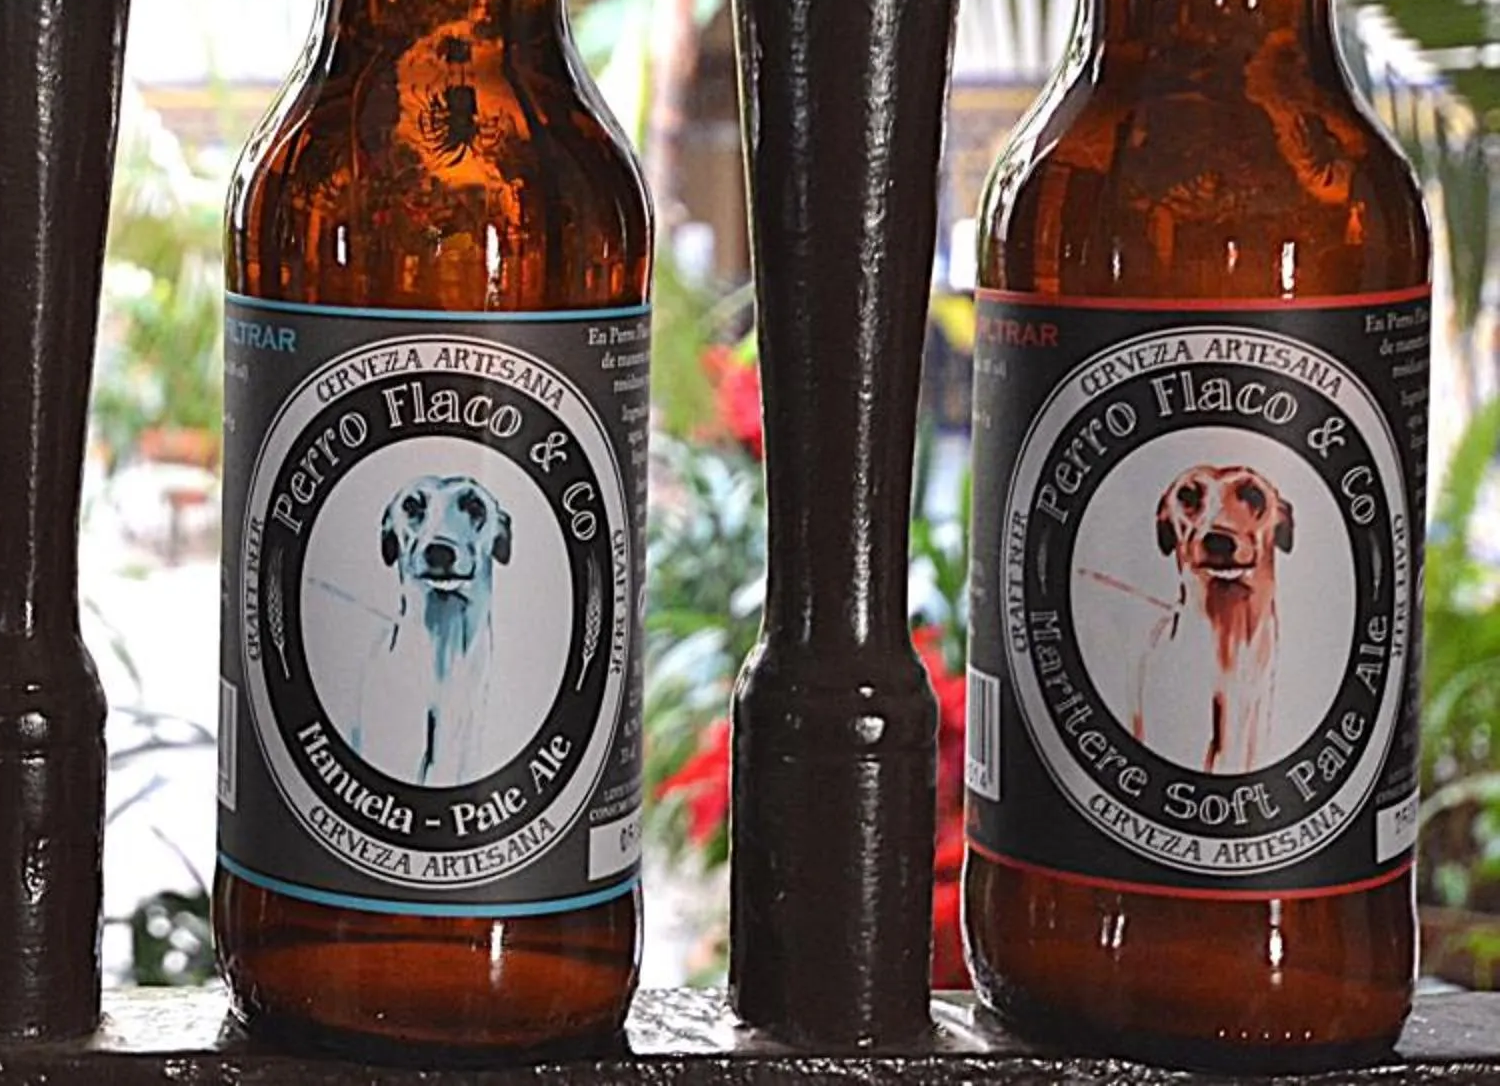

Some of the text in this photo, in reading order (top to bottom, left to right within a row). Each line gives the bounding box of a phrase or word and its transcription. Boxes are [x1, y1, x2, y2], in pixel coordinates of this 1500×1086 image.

[226, 317, 296, 352] LTRAR
[978, 316, 1058, 348] LTRAR
[433, 347, 566, 410] ARTESANA
[1204, 337, 1343, 399] ARTESANA
[273, 381, 597, 541] Perro Flaco & Co
[1035, 401, 1138, 525] Perro
[1150, 370, 1298, 425] Flaco
[1307, 416, 1346, 459] &
[1341, 465, 1376, 525] Co
[1164, 782, 1281, 826] Soft
[1286, 710, 1366, 803] Pale
[1355, 615, 1388, 696] Ale
[298, 721, 415, 835] Manuela
[450, 785, 527, 837] Pale
[529, 734, 572, 794] Ale
[422, 817, 556, 877] ARTESANA
[1213, 801, 1347, 864] ARTESANA
